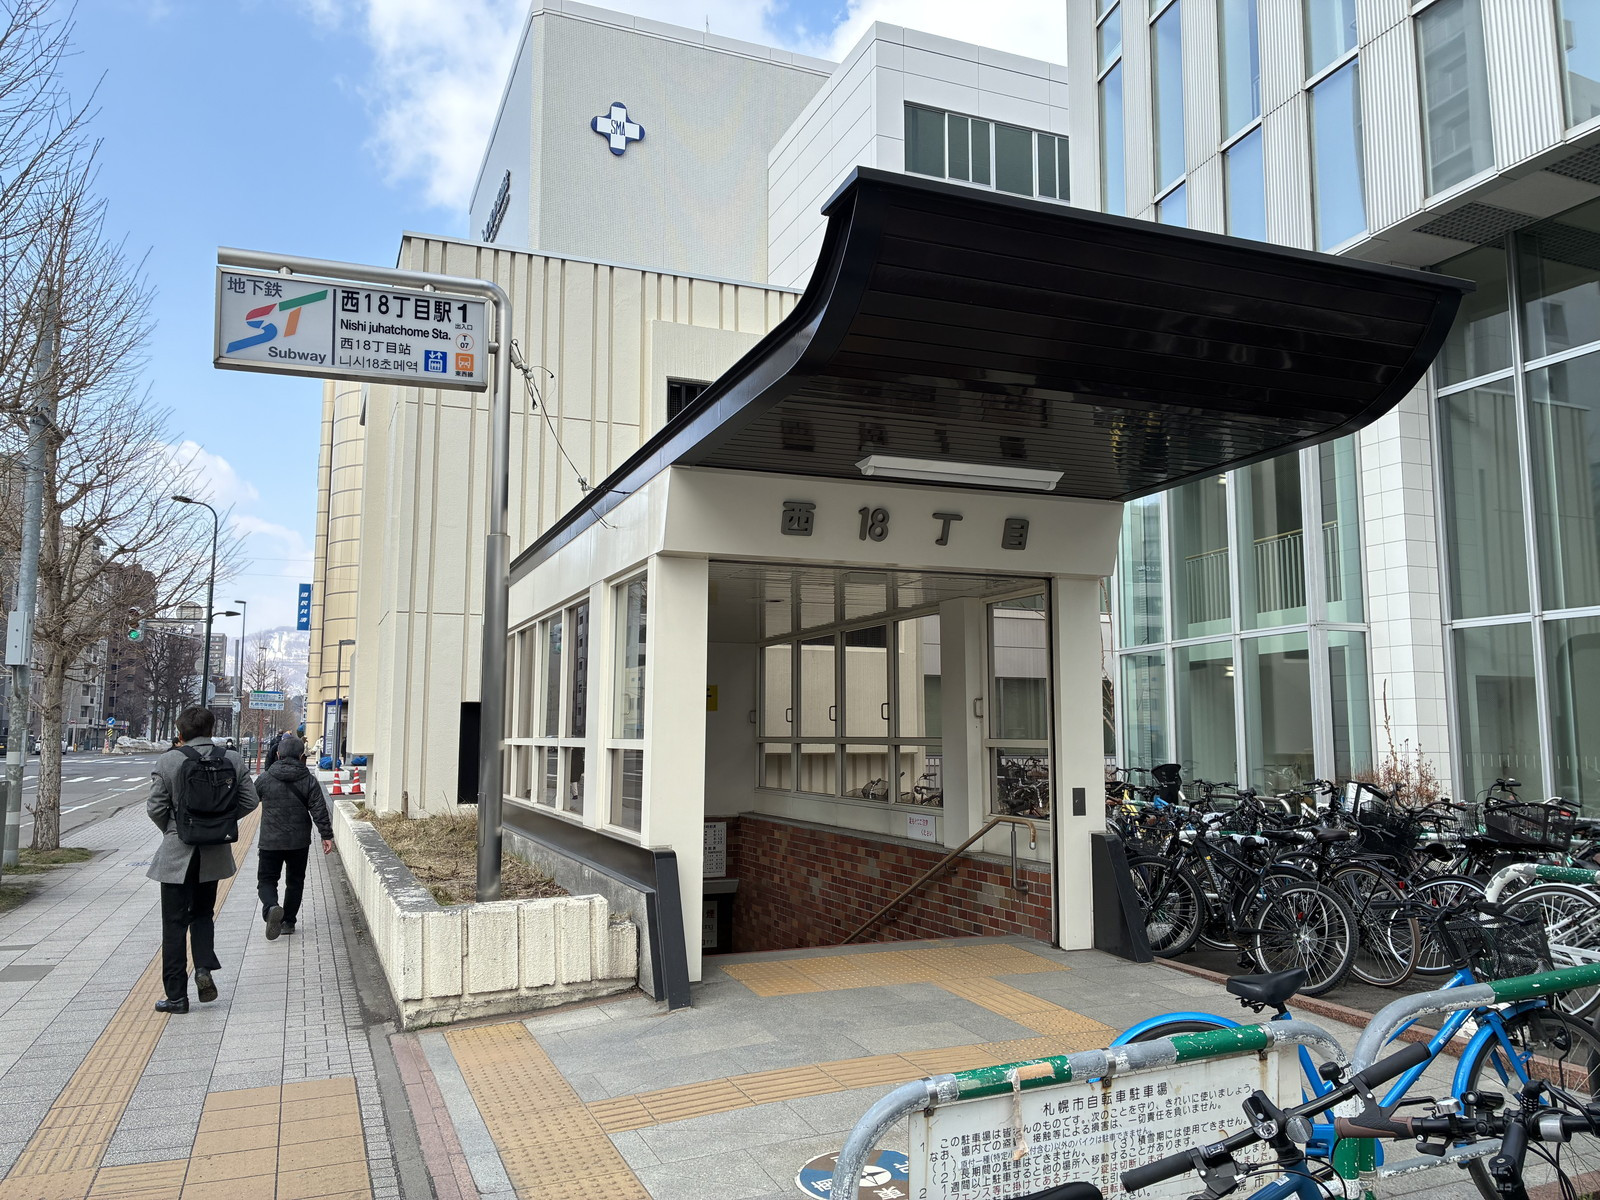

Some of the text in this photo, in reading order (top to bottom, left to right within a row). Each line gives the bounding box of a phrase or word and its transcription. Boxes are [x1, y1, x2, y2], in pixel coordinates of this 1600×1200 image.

[611, 120, 625, 136] SMA
[227, 277, 282, 298] 地下鉄
[341, 290, 468, 323] 西18丁目駅 1
[340, 319, 451, 340] Nishi juhatchome Sta.
[268, 346, 326, 364] Subway
[340, 337, 411, 355] 西18丁目站
[340, 355, 418, 373] 니시18초메역
[781, 501, 1029, 550] 西18丁目
[1042, 1082, 1168, 1117] 札幌市自転車駐車場
[929, 1102, 1222, 1161] なお、場内での盗接触等による損害は、一切責任を負いません。
[1137, 1117, 1247, 1146] 積雪期には使用できません。
